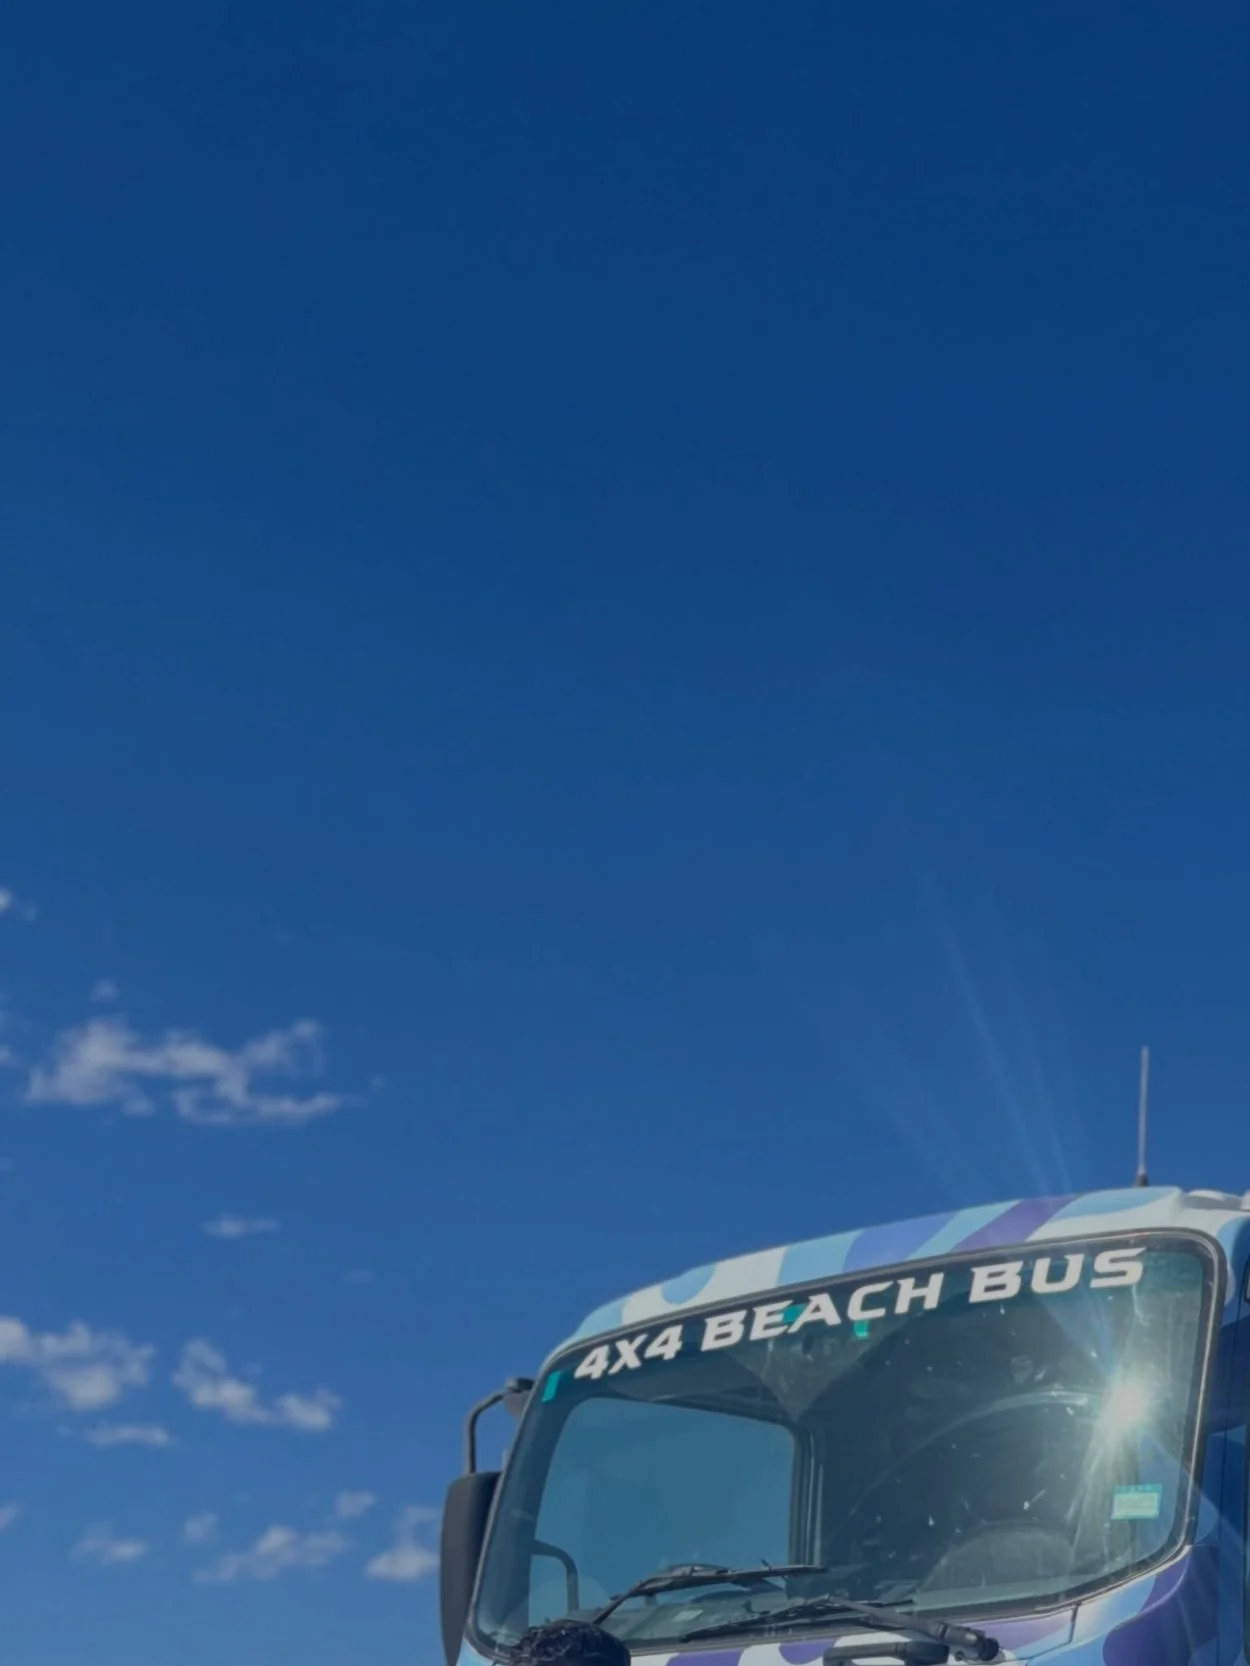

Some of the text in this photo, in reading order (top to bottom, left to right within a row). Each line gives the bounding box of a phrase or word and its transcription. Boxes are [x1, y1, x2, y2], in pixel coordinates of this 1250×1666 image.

[574, 1247, 1146, 1379] 4X4 BEACH BUS
